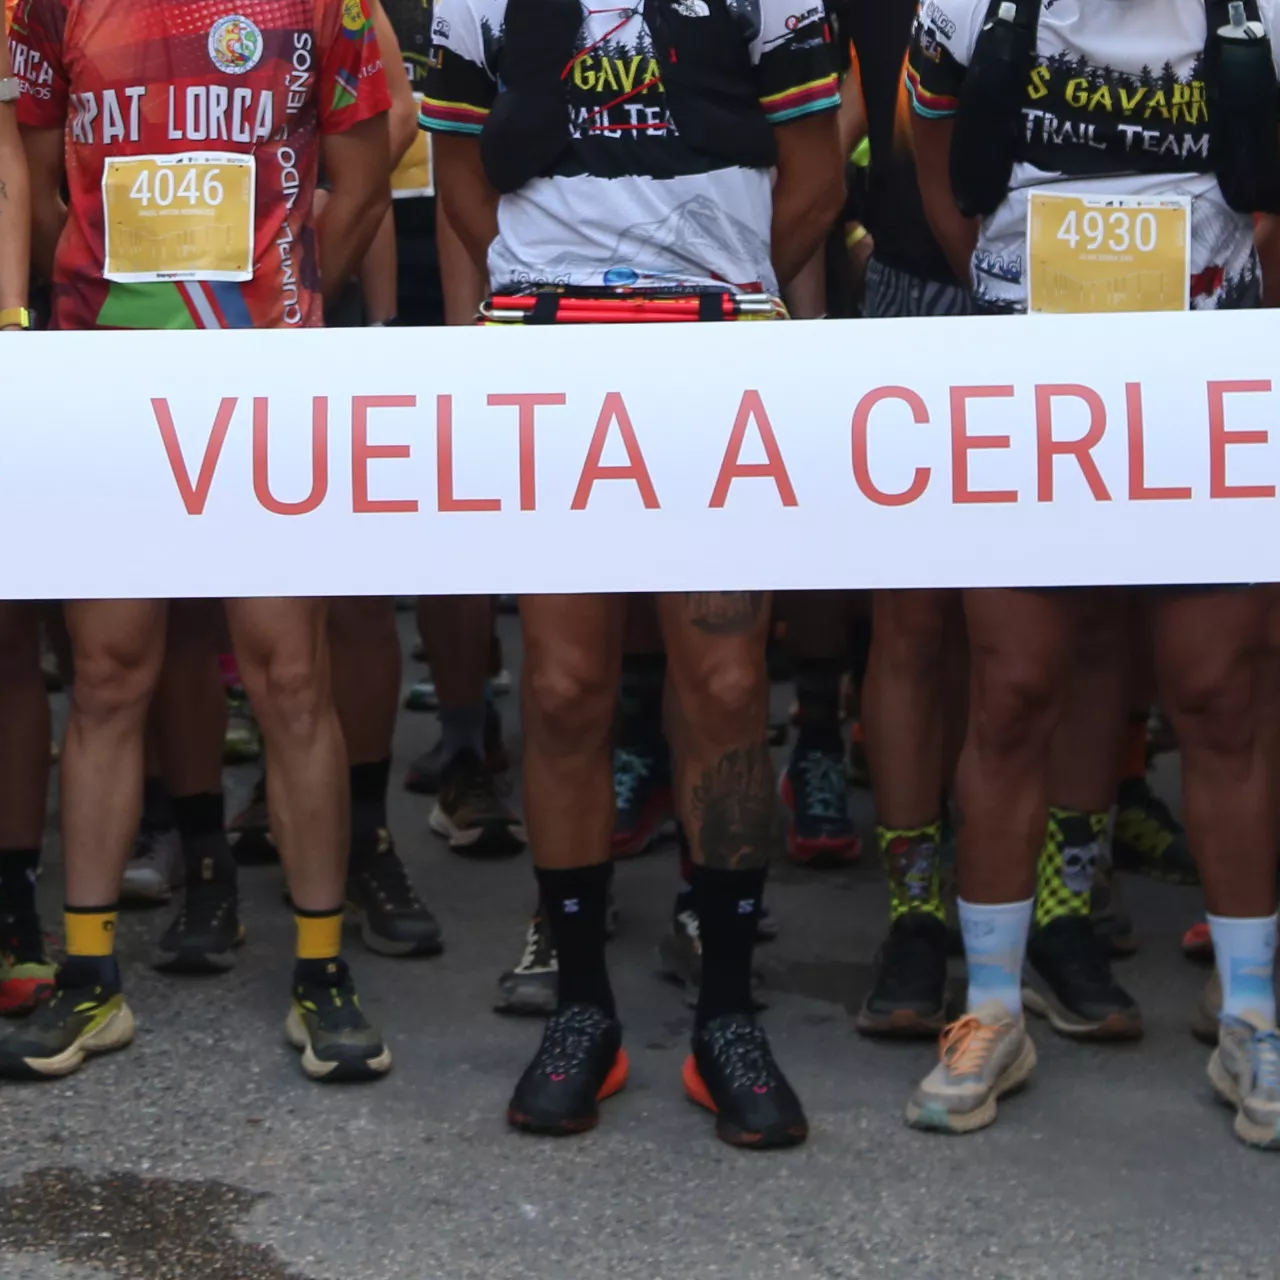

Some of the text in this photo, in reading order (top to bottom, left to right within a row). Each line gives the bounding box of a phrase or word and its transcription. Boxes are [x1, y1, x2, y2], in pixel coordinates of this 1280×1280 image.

[168, 84, 275, 144] LORCA
[1021, 107, 1211, 160] TRAIL TEAM
[129, 168, 224, 207] 4046
[1056, 209, 1158, 252] 4930
[152, 393, 661, 516] VUELTA
[708, 390, 799, 509] A
